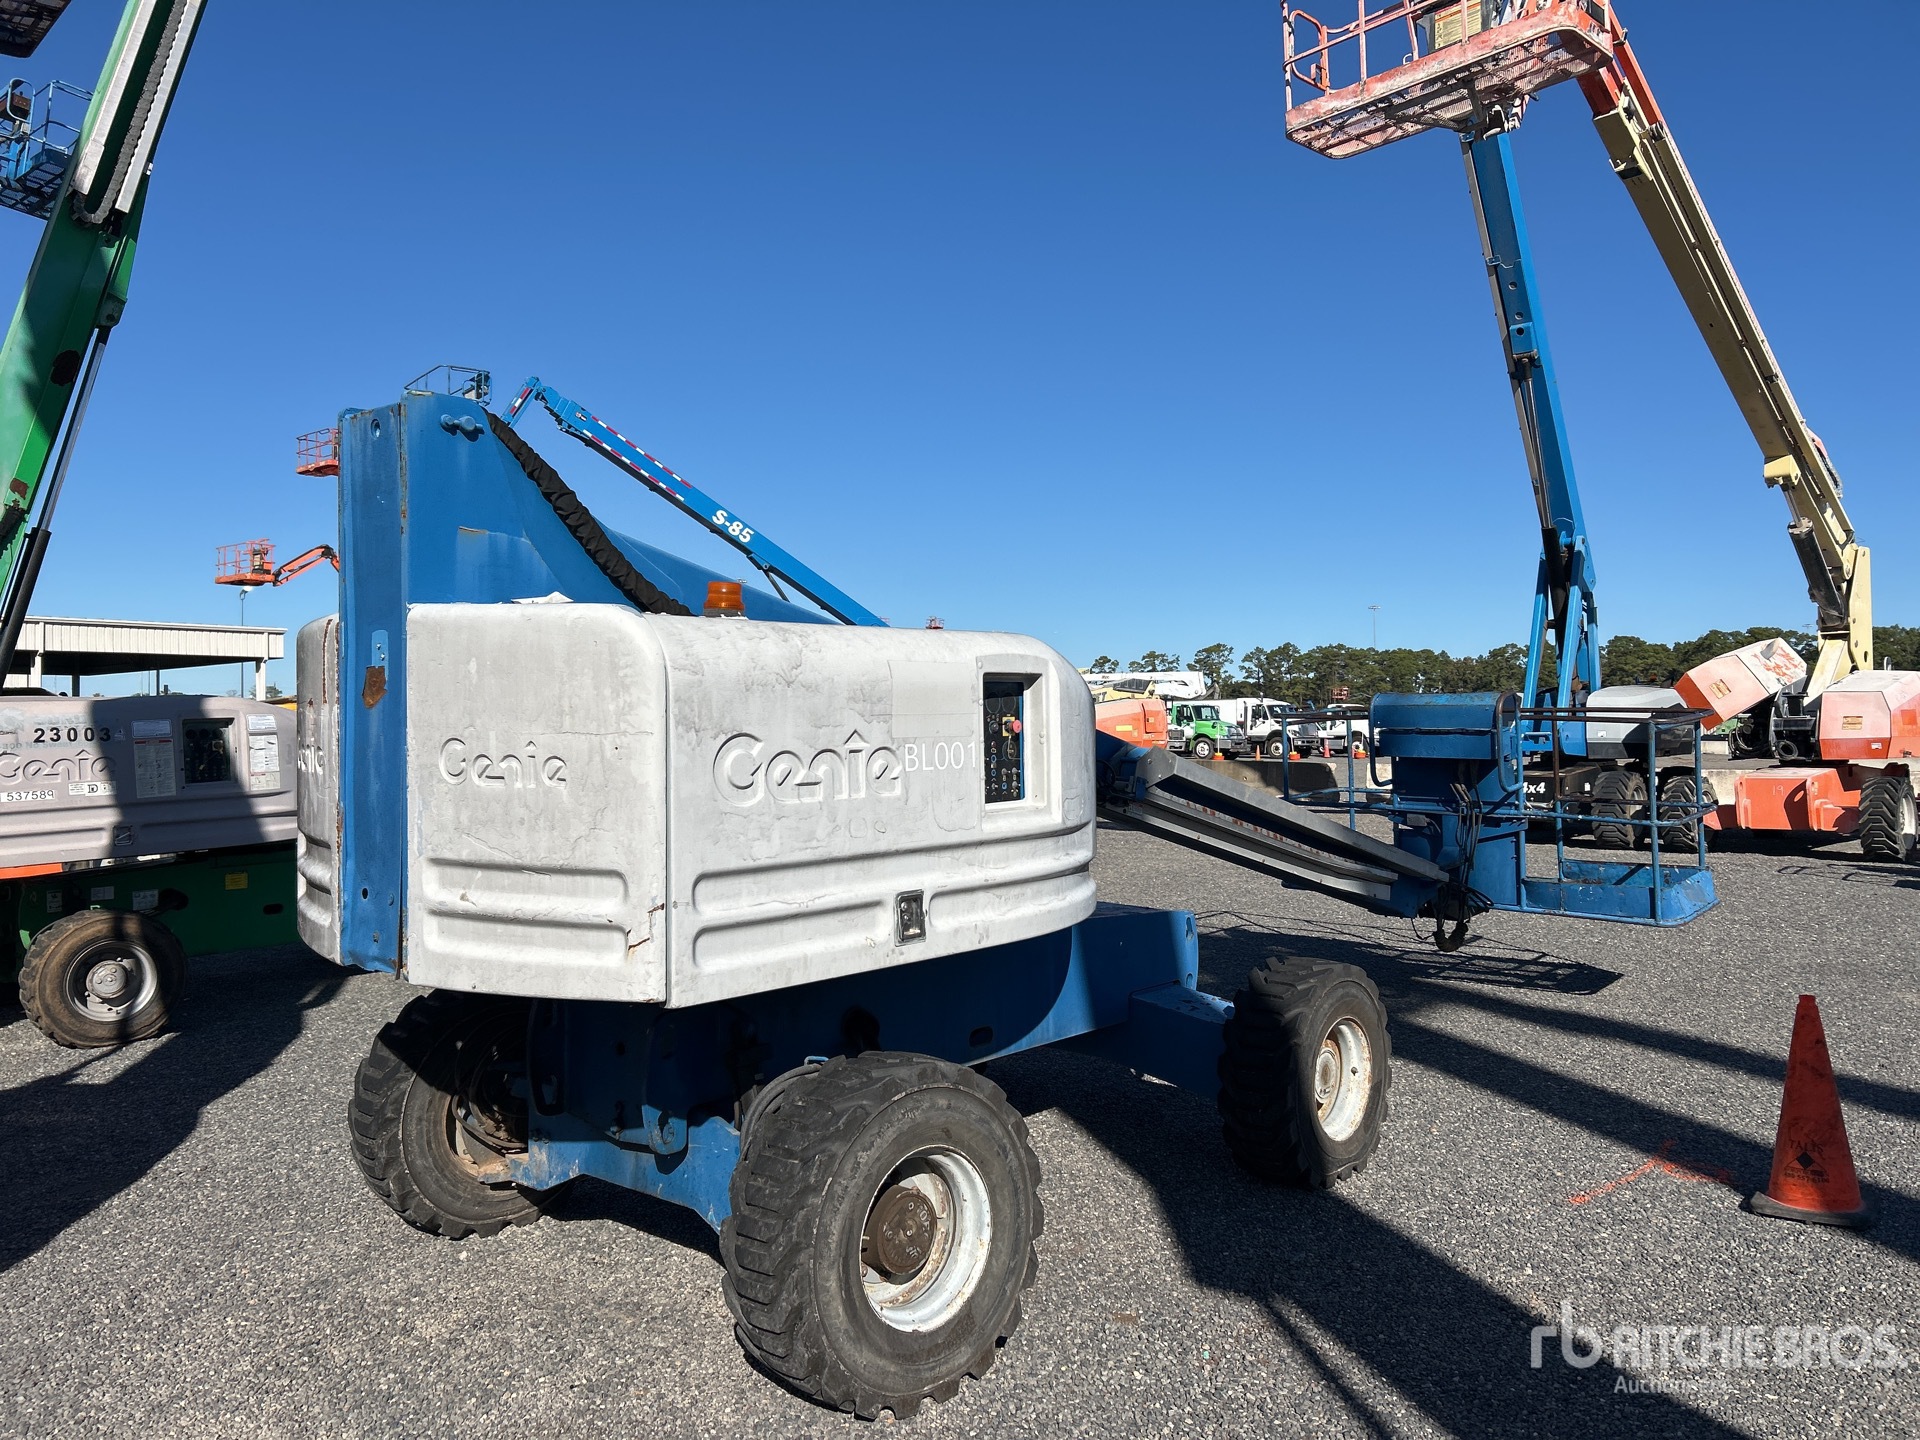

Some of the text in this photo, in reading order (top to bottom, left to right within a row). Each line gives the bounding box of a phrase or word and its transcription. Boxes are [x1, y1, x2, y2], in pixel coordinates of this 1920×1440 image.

[712, 510, 754, 542] S-85
[33, 727, 111, 743] 23003
[0, 749, 117, 785] Genie
[439, 737, 567, 789] Genie
[711, 730, 900, 806] Genie
[904, 740, 976, 771] BL001
[6, 790, 54, 801] 537589
